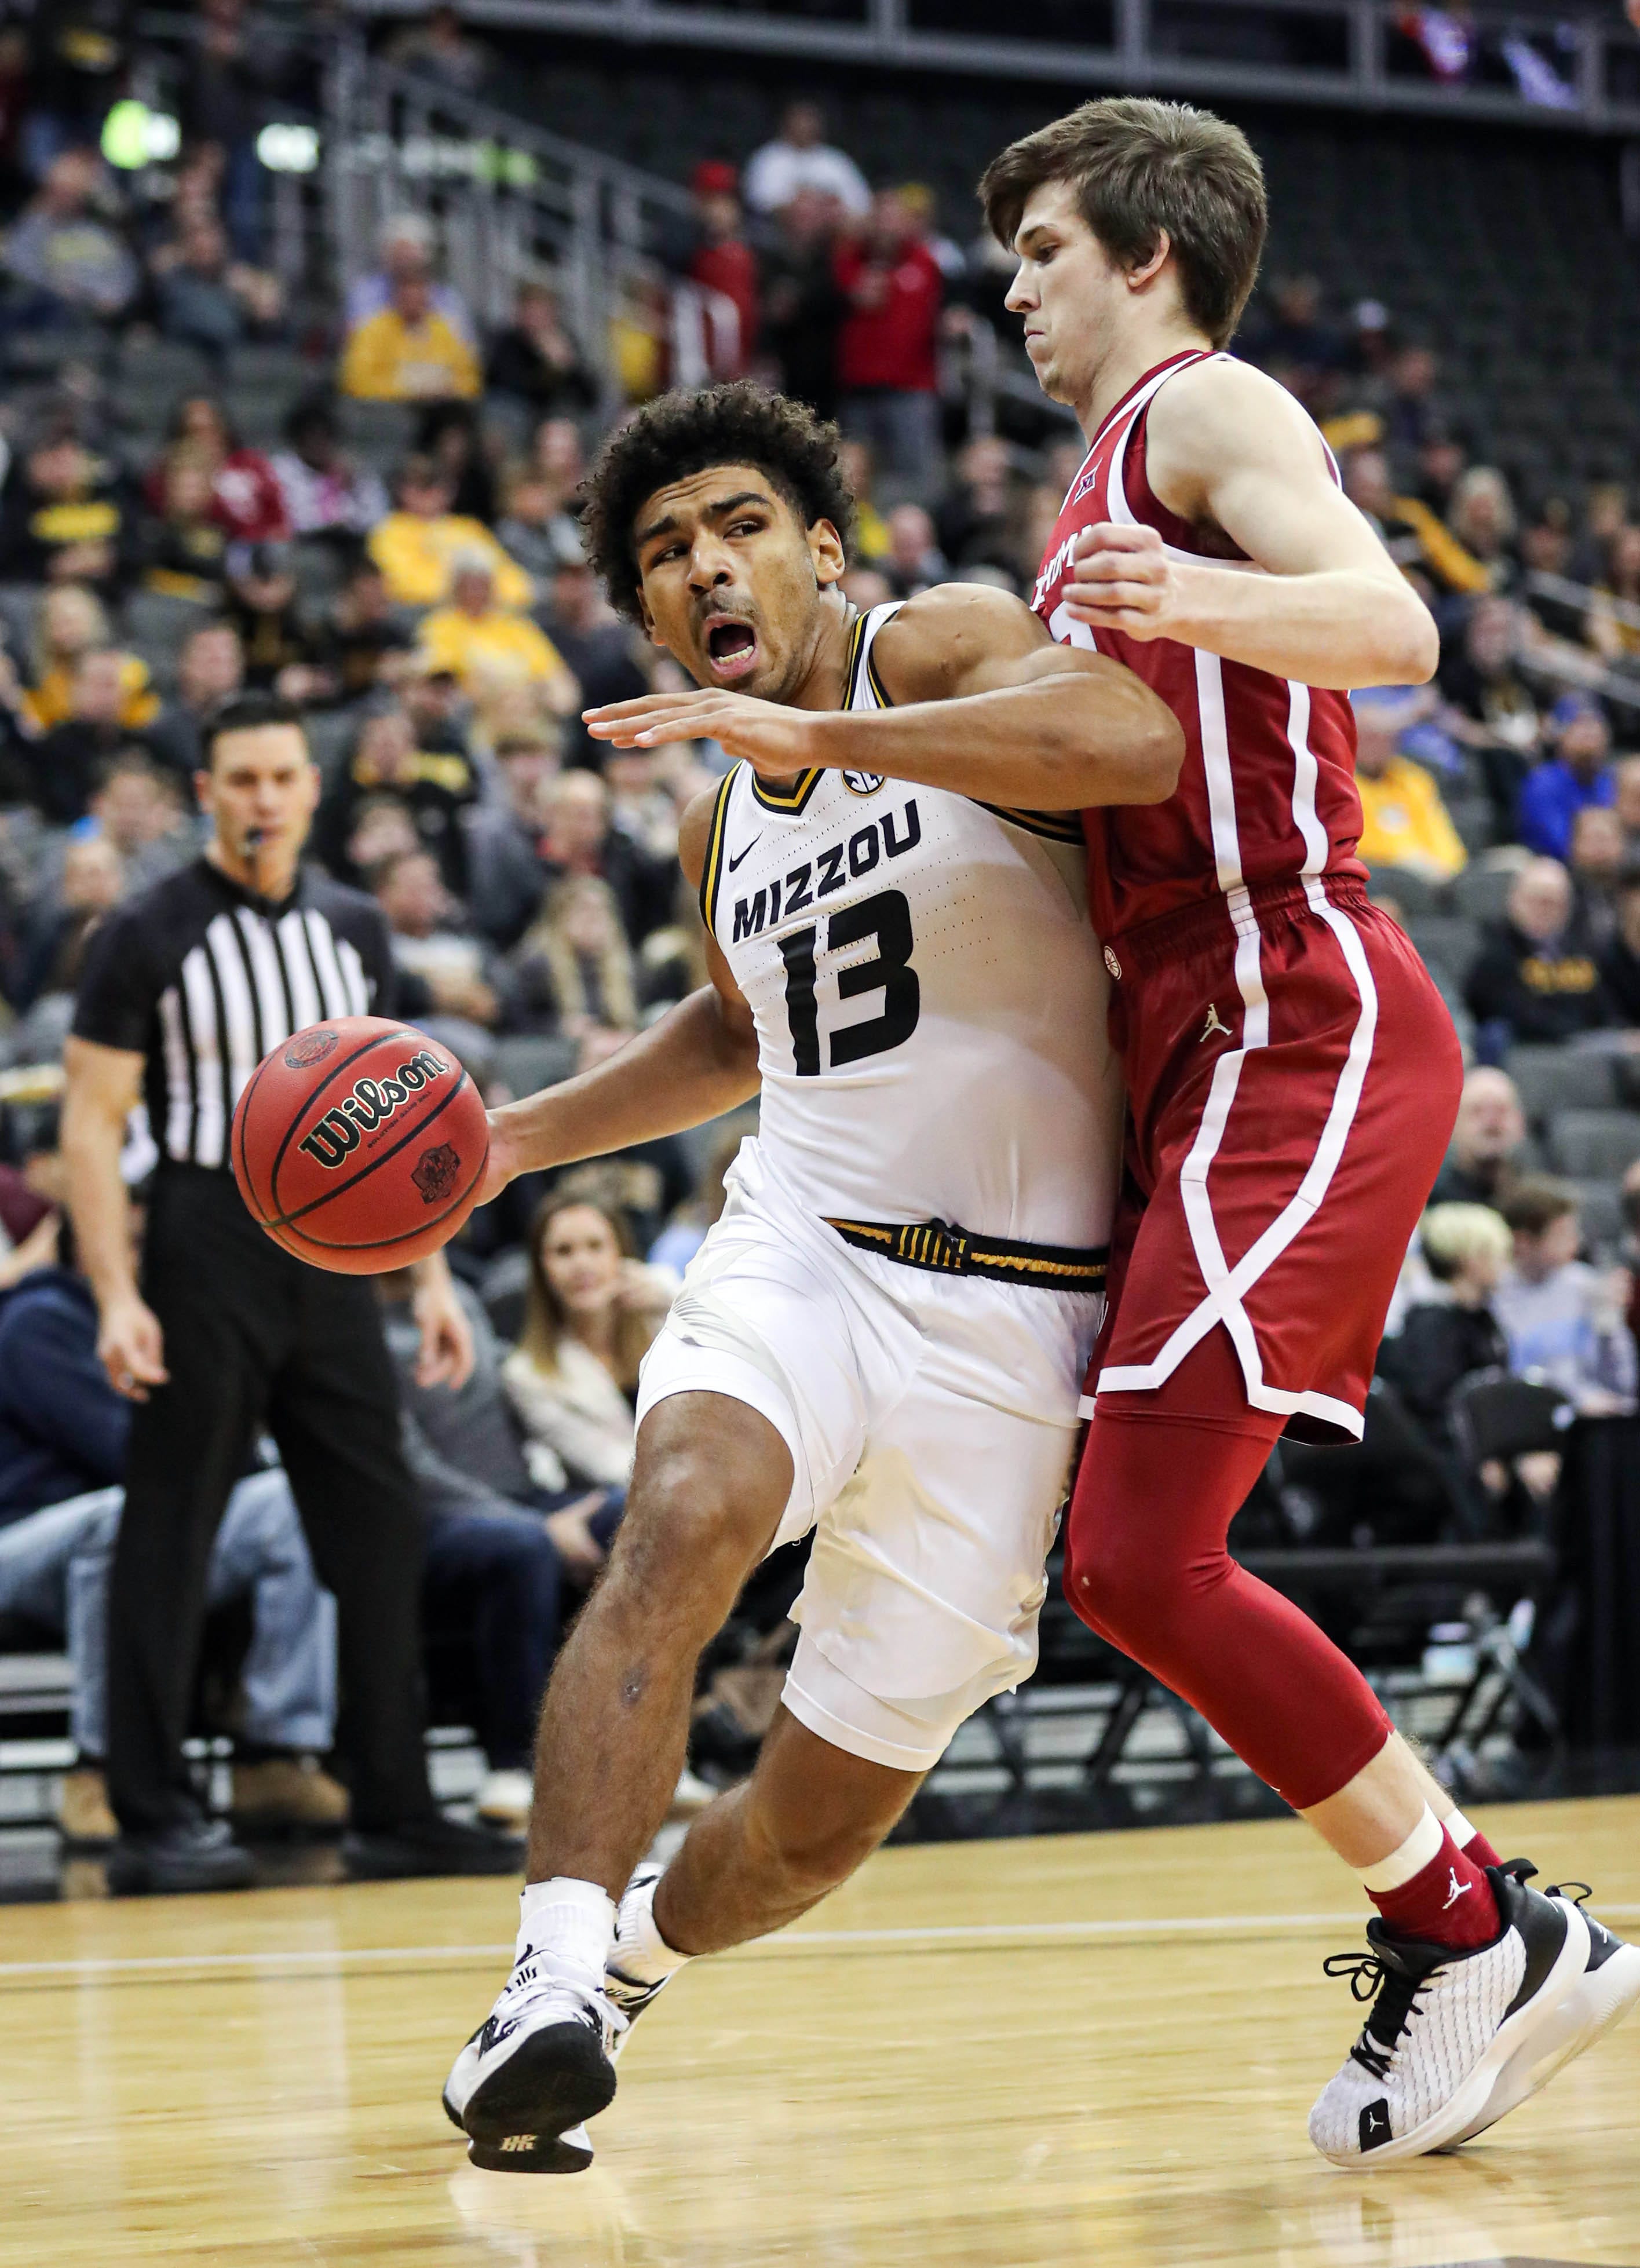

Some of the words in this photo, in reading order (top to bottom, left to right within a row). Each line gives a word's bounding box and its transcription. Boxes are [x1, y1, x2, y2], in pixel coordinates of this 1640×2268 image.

[733, 798, 921, 944] MIZZOU
[776, 889, 920, 1076] 13
[298, 1051, 448, 1168] Wilson
